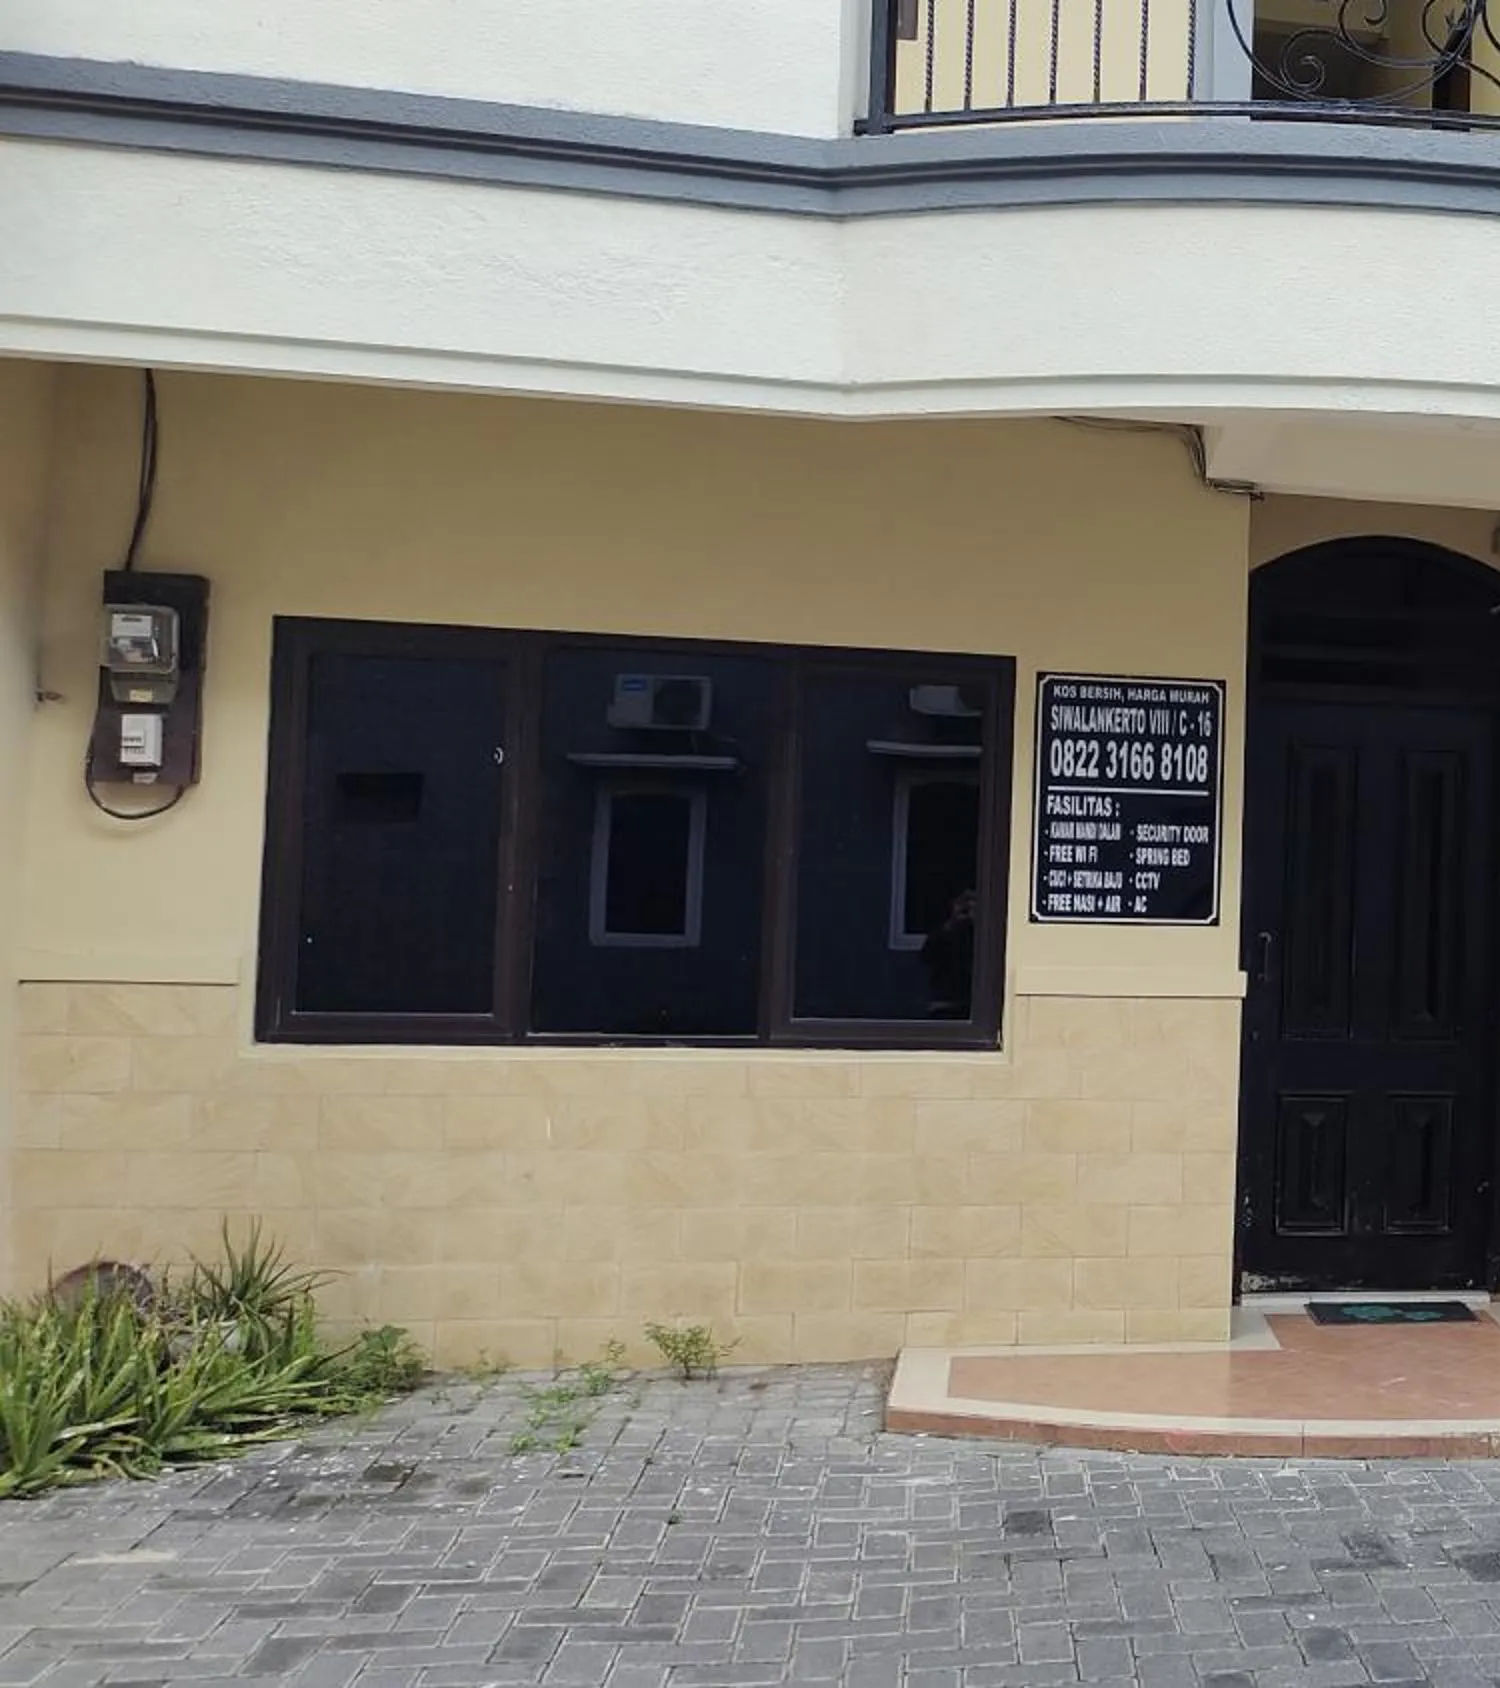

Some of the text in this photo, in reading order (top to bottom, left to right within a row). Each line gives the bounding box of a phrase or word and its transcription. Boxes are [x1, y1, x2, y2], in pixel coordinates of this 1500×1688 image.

[1053, 685, 1077, 698] KOS
[1127, 687, 1167, 701] HARGA
[1169, 689, 1209, 704] MURAH
[1051, 704, 1146, 734] SIWALANKERTO
[1051, 738, 1208, 783] 0822 3166 8108
[1136, 824, 1209, 843] SECURITY DOOR
[1049, 845, 1073, 863] FREE
[1136, 847, 1190, 867] SPRING BED
[1135, 871, 1160, 891] CCTV
[1048, 893, 1073, 912] FREE
[1073, 894, 1096, 913] NASI
[1104, 895, 1121, 913] AIR
[1134, 895, 1147, 913] AC
